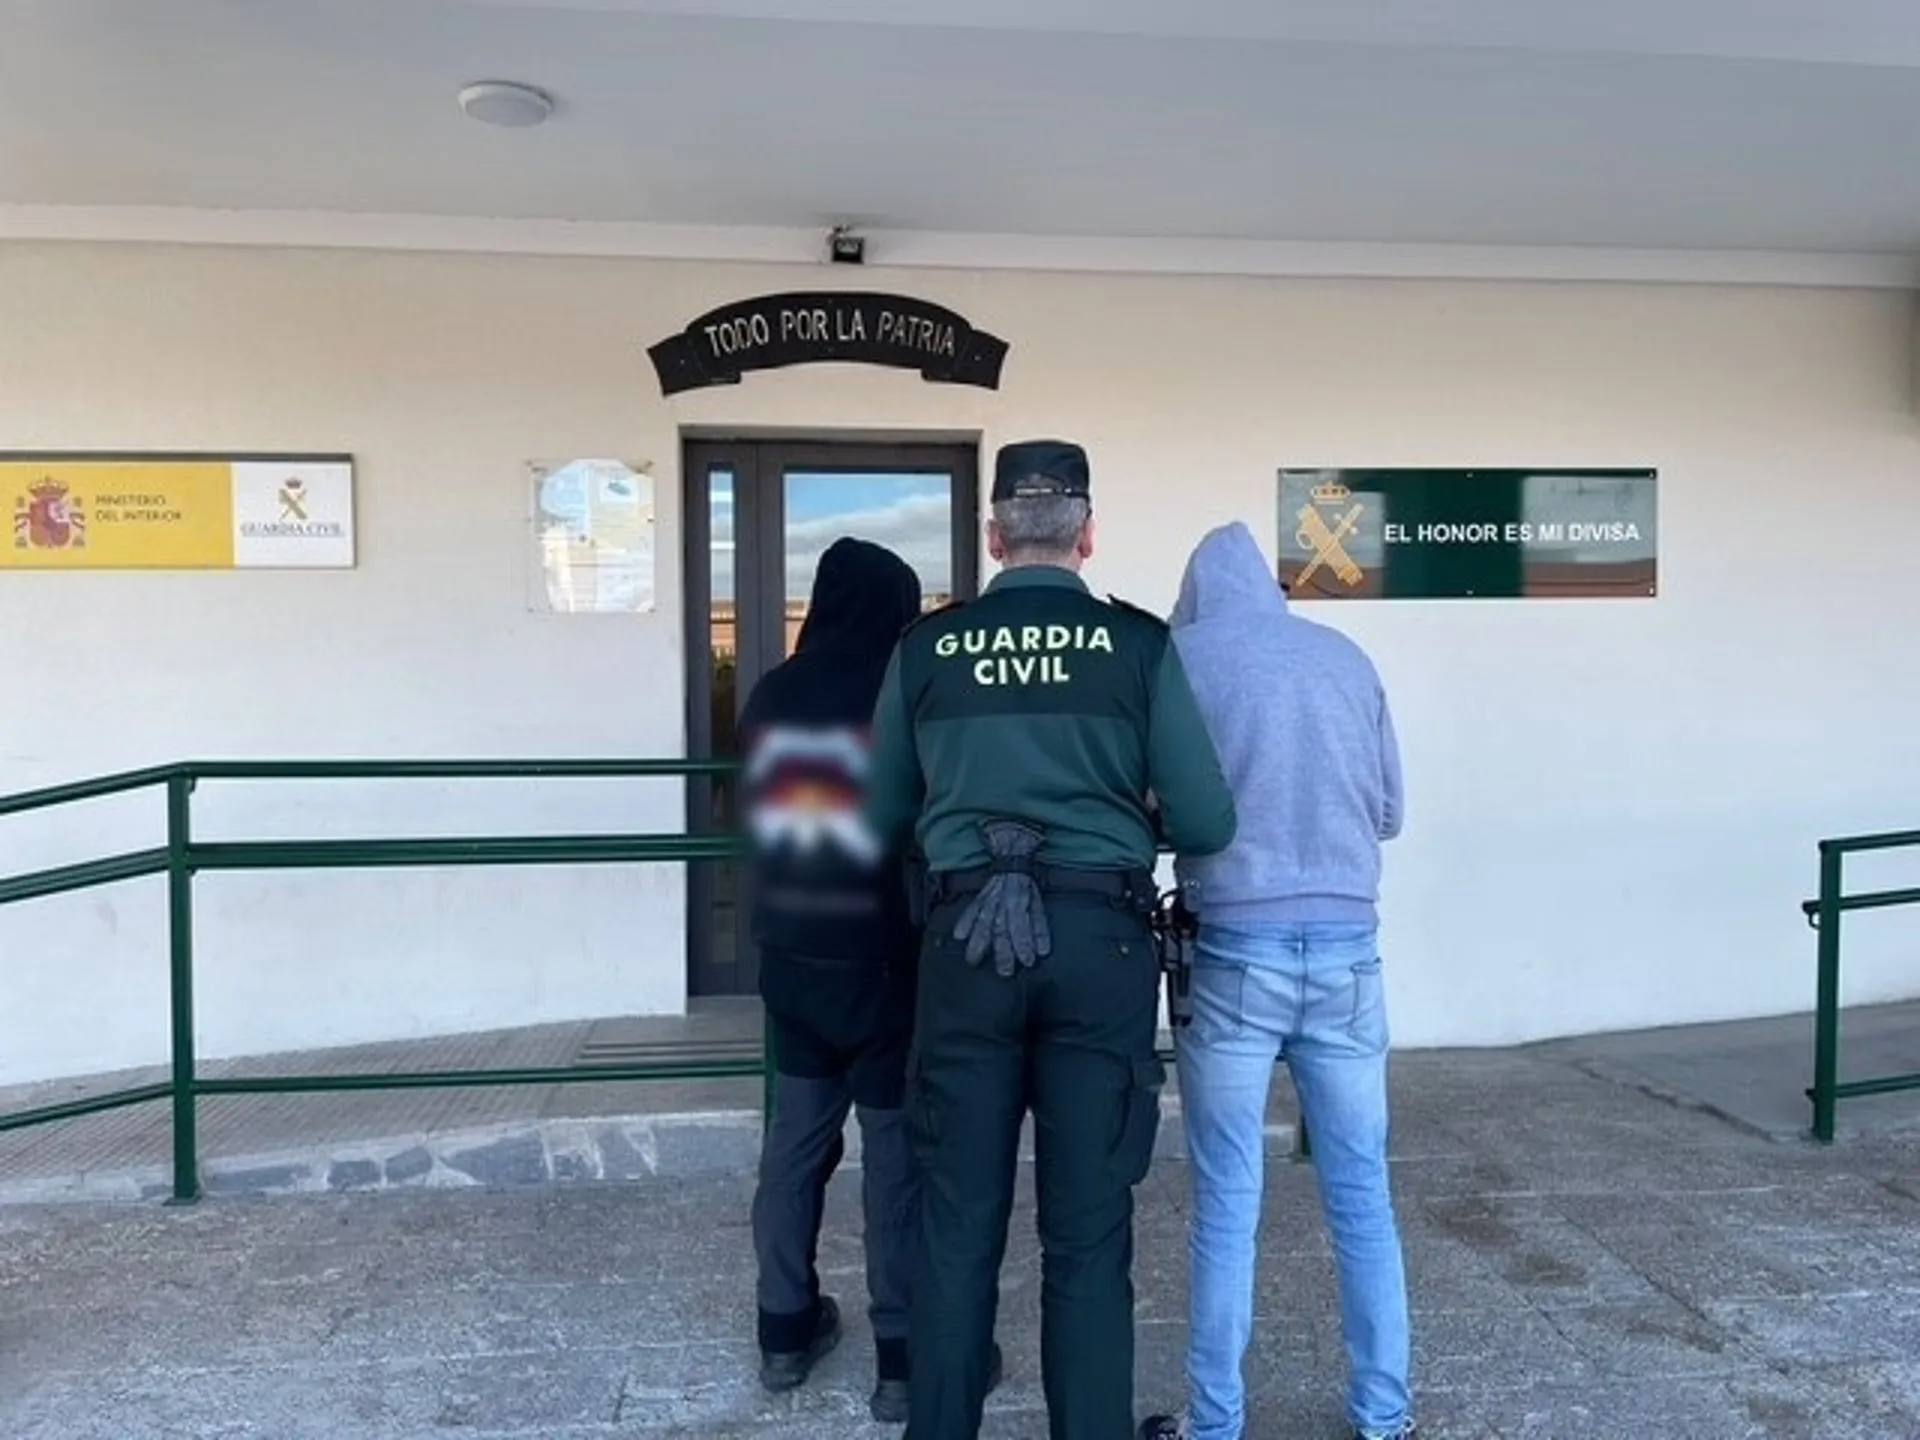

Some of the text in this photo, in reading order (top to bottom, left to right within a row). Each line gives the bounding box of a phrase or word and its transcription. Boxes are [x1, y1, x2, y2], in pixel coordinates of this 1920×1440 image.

[704, 309, 956, 357] TODO POR LA PATRIA
[95, 494, 167, 507] MINISTERIO
[95, 510, 182, 522] DEL INTERIOR
[240, 523, 343, 537] GUARDIA CIVIL
[1384, 522, 1640, 543] EL HONOR ES MI DIVISA
[934, 624, 1113, 657] GUARDIA
[973, 656, 1071, 686] CIVIL
